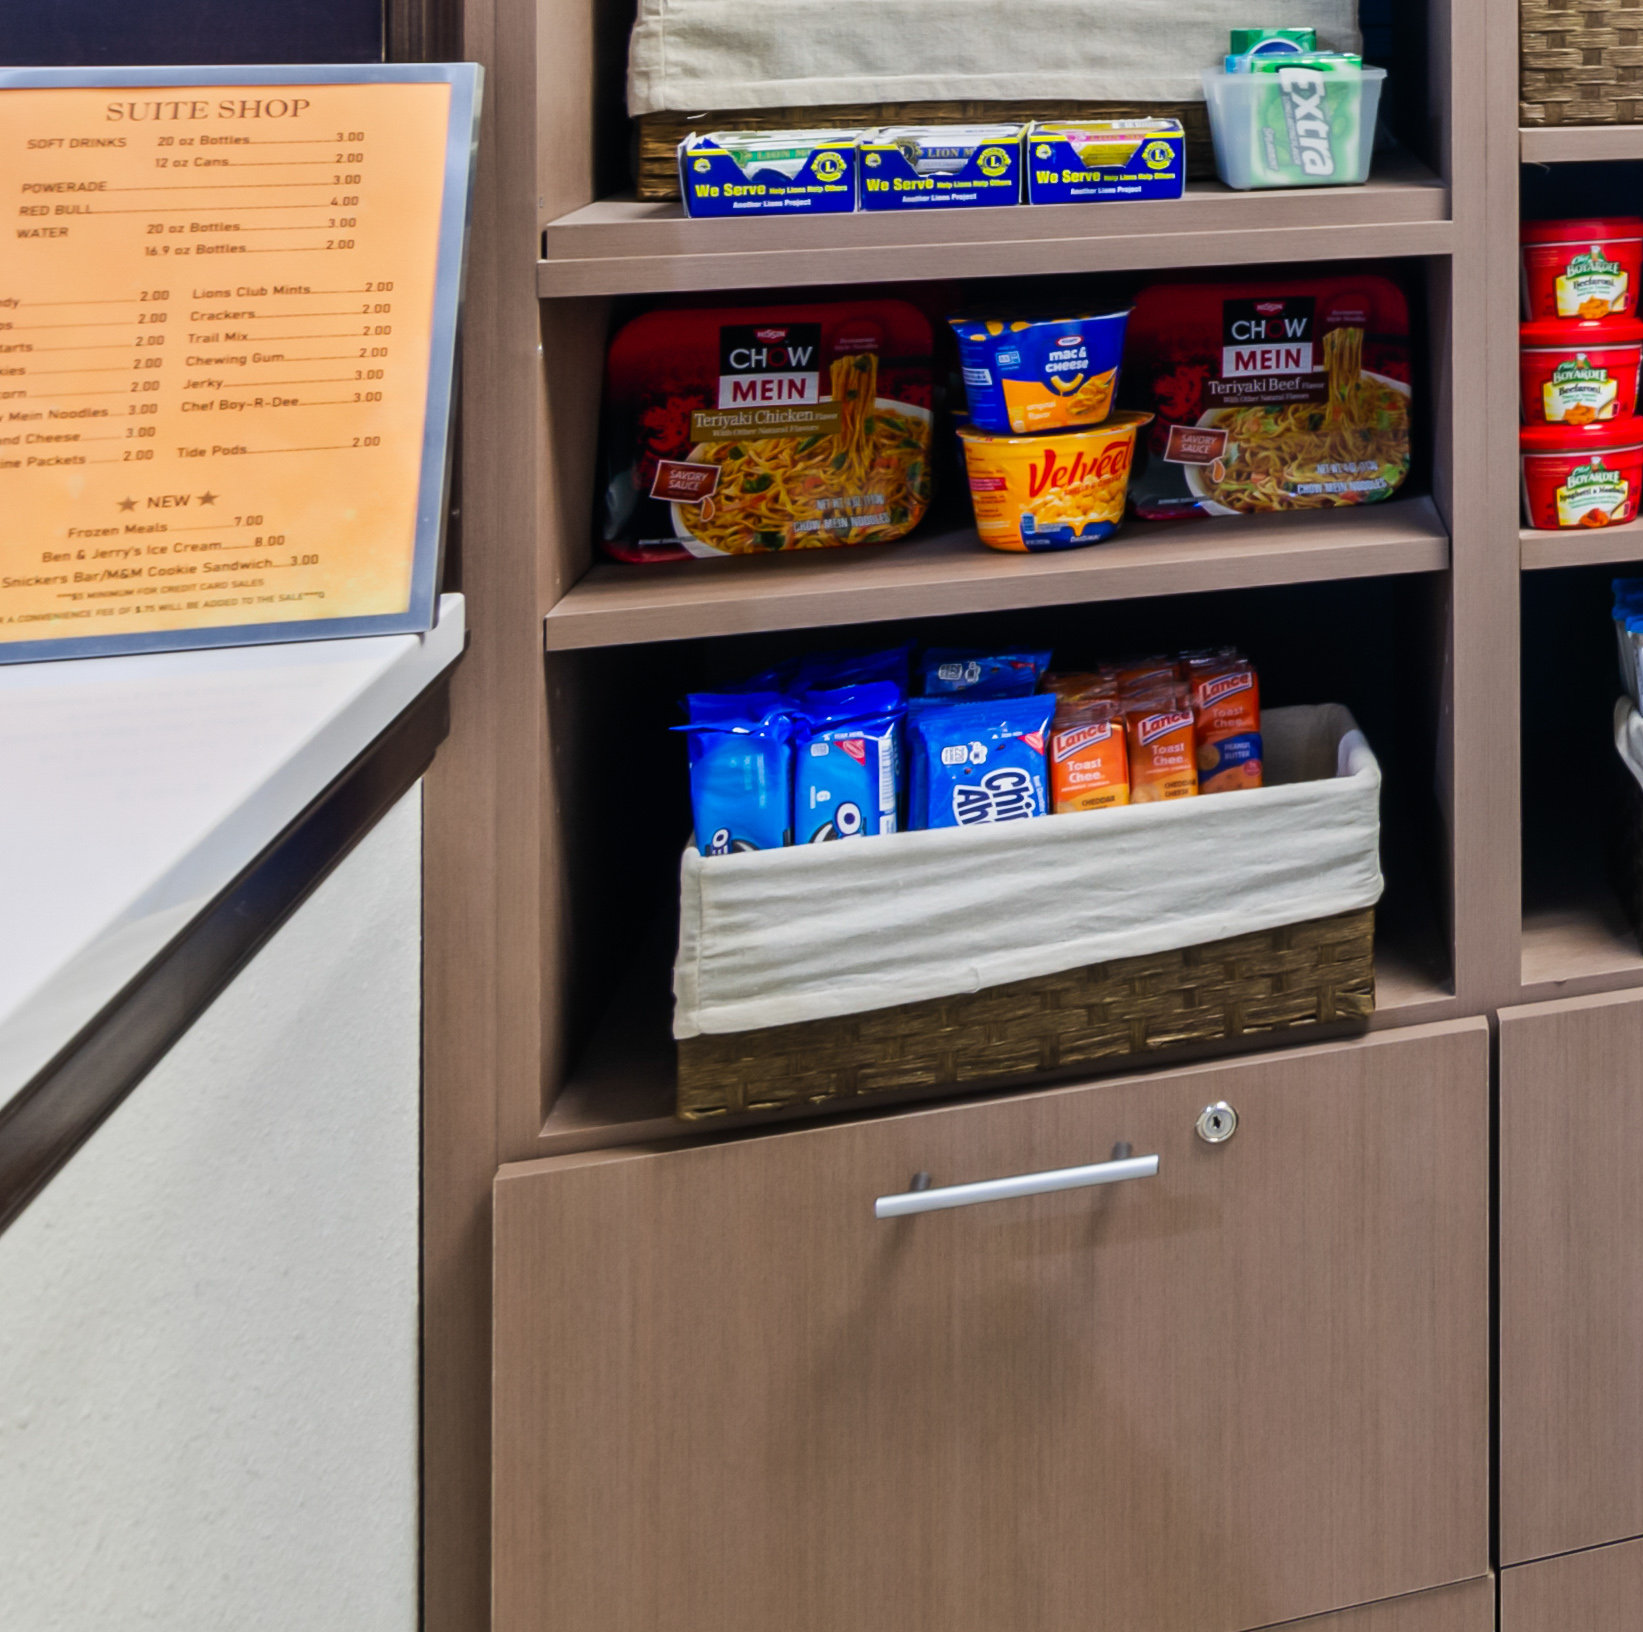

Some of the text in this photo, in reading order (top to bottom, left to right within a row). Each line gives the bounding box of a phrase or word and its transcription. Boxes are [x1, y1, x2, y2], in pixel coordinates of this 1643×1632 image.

[105, 99, 310, 121] SUITE SHOP
[1278, 67, 1336, 176] Extra
[27, 132, 364, 149] SOFT DRINKS 20 oz Bottles 3.00
[21, 174, 361, 193] POWERADE 3.00
[695, 183, 766, 198] We Serve
[19, 196, 359, 216] RED BULL 4.00
[193, 282, 393, 299] Lions Club Mints 2.00
[190, 303, 391, 321] Crackers 2.00
[188, 325, 391, 343] Trail Mix 2.00
[1231, 318, 1307, 340] CHOW
[185, 347, 388, 367] Chewing Gum 2.00
[729, 346, 813, 369] CHOW
[1235, 348, 1302, 371] MEIN
[182, 369, 384, 390] Jerky 3.00
[1208, 376, 1302, 396] Teriyaki Beef
[732, 378, 807, 403] MEIN
[694, 408, 814, 430] Teriyaki Chicken
[177, 436, 381, 458] Tide Pods 2.00
[147, 494, 191, 508] NEW
[68, 515, 263, 539] Frozen Meals 7.00
[42, 551, 71, 563] Ben
[76, 549, 85, 561] &
[91, 545, 142, 561] Jerry's
[147, 544, 168, 555] Ice
[173, 541, 222, 553] Cream
[1202, 672, 1250, 700] Lance
[1055, 721, 1108, 753] Lance
[1067, 758, 1102, 774] Toast
